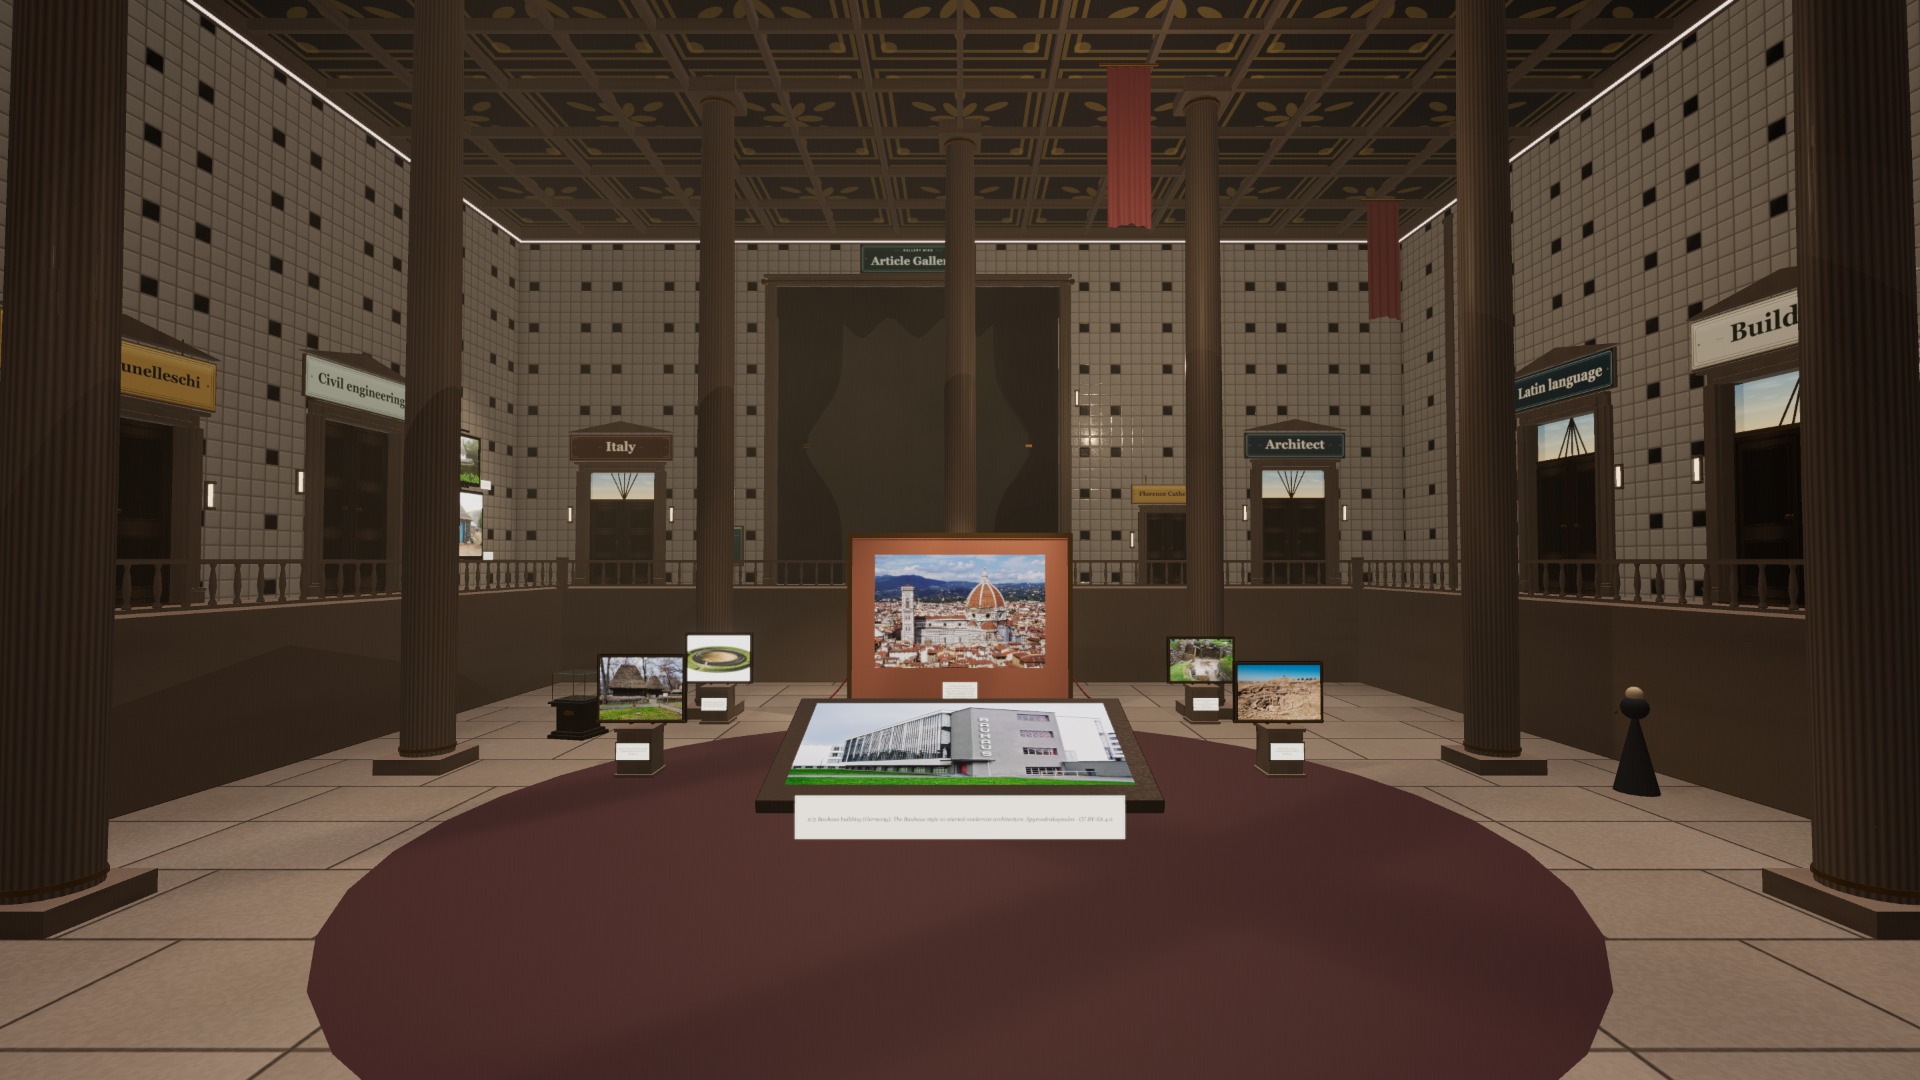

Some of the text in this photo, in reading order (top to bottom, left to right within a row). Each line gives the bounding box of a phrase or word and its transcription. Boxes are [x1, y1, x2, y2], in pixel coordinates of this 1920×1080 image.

[870, 255, 911, 266] Article
[1730, 303, 1798, 343] Build
[121, 362, 201, 389] unelleschi
[1517, 366, 1603, 400] Latin language
[318, 372, 405, 409] Civil engineering
[605, 440, 636, 455] Italy
[1264, 438, 1326, 450] Architect
